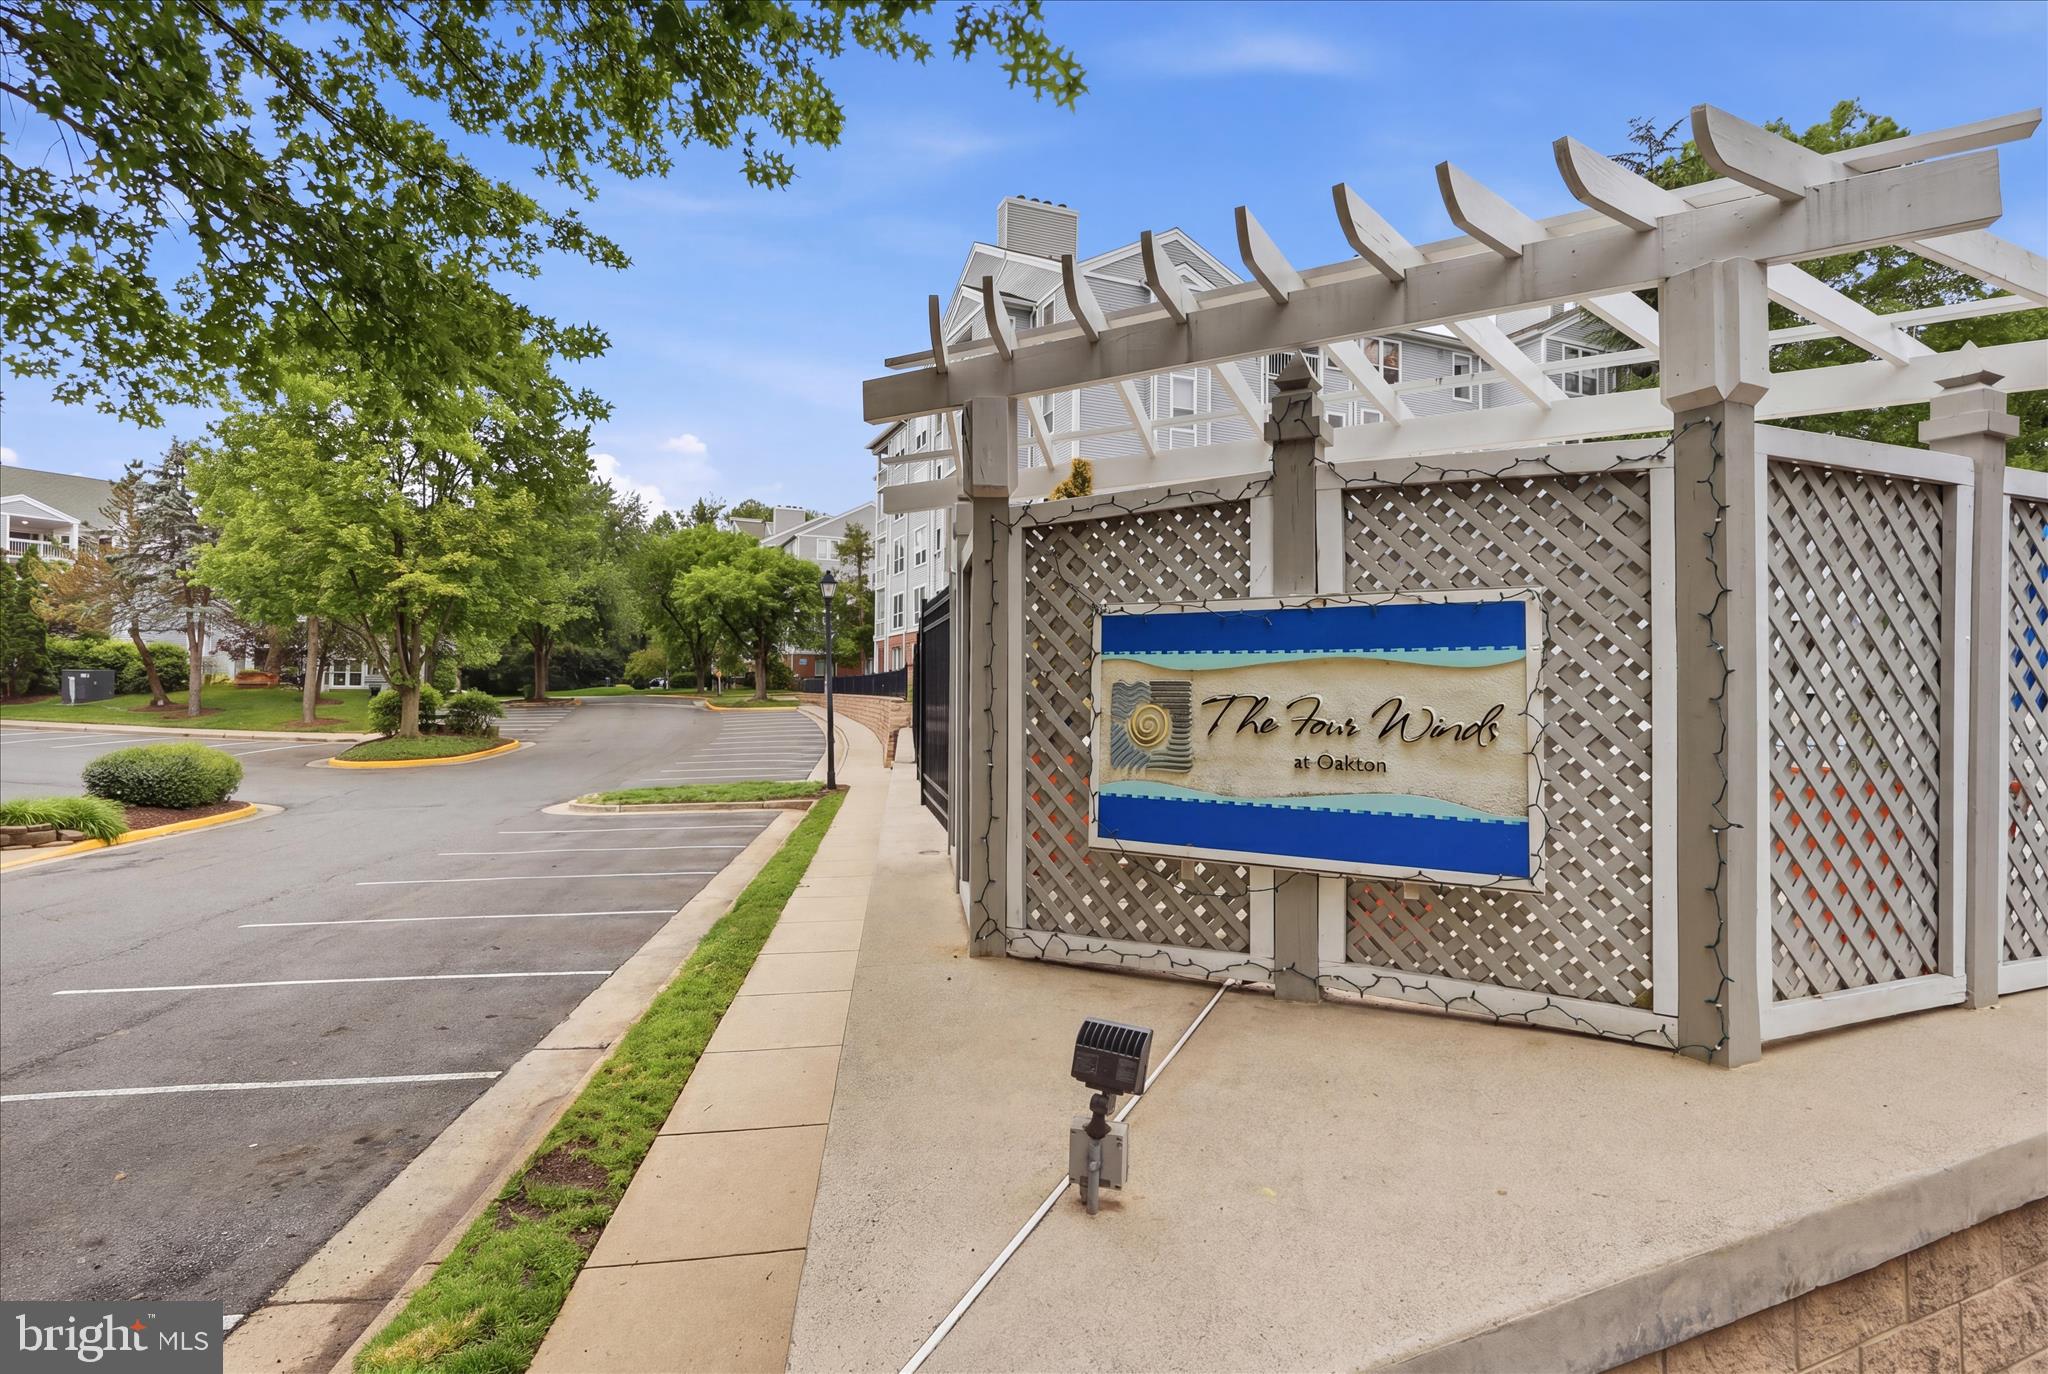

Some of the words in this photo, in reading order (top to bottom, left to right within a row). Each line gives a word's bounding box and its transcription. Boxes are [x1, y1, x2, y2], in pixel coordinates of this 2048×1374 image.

[1201, 693, 1279, 737] The
[1287, 695, 1361, 738] Four
[1371, 696, 1505, 747] Winds
[1294, 756, 1310, 769] at
[1318, 754, 1387, 773] Oakton
